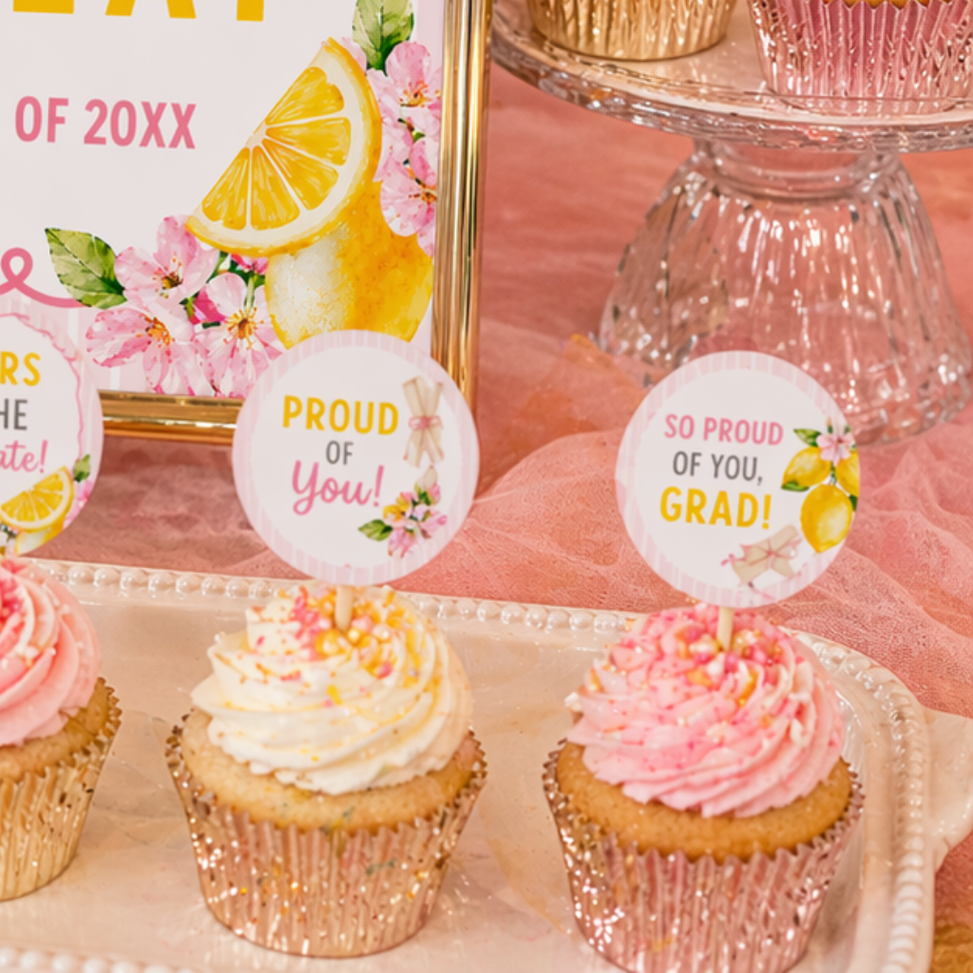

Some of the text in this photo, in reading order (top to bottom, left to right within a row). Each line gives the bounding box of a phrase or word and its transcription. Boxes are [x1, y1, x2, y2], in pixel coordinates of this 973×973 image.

[15, 96, 69, 143] OF
[84, 99, 196, 149] 20XX
[282, 395, 399, 435] PROUD
[665, 414, 783, 445] SO PROUD
[326, 441, 353, 465] OF
[673, 451, 762, 485] OF YOU,
[291, 459, 384, 517] You!
[660, 486, 772, 530] GRAD!
